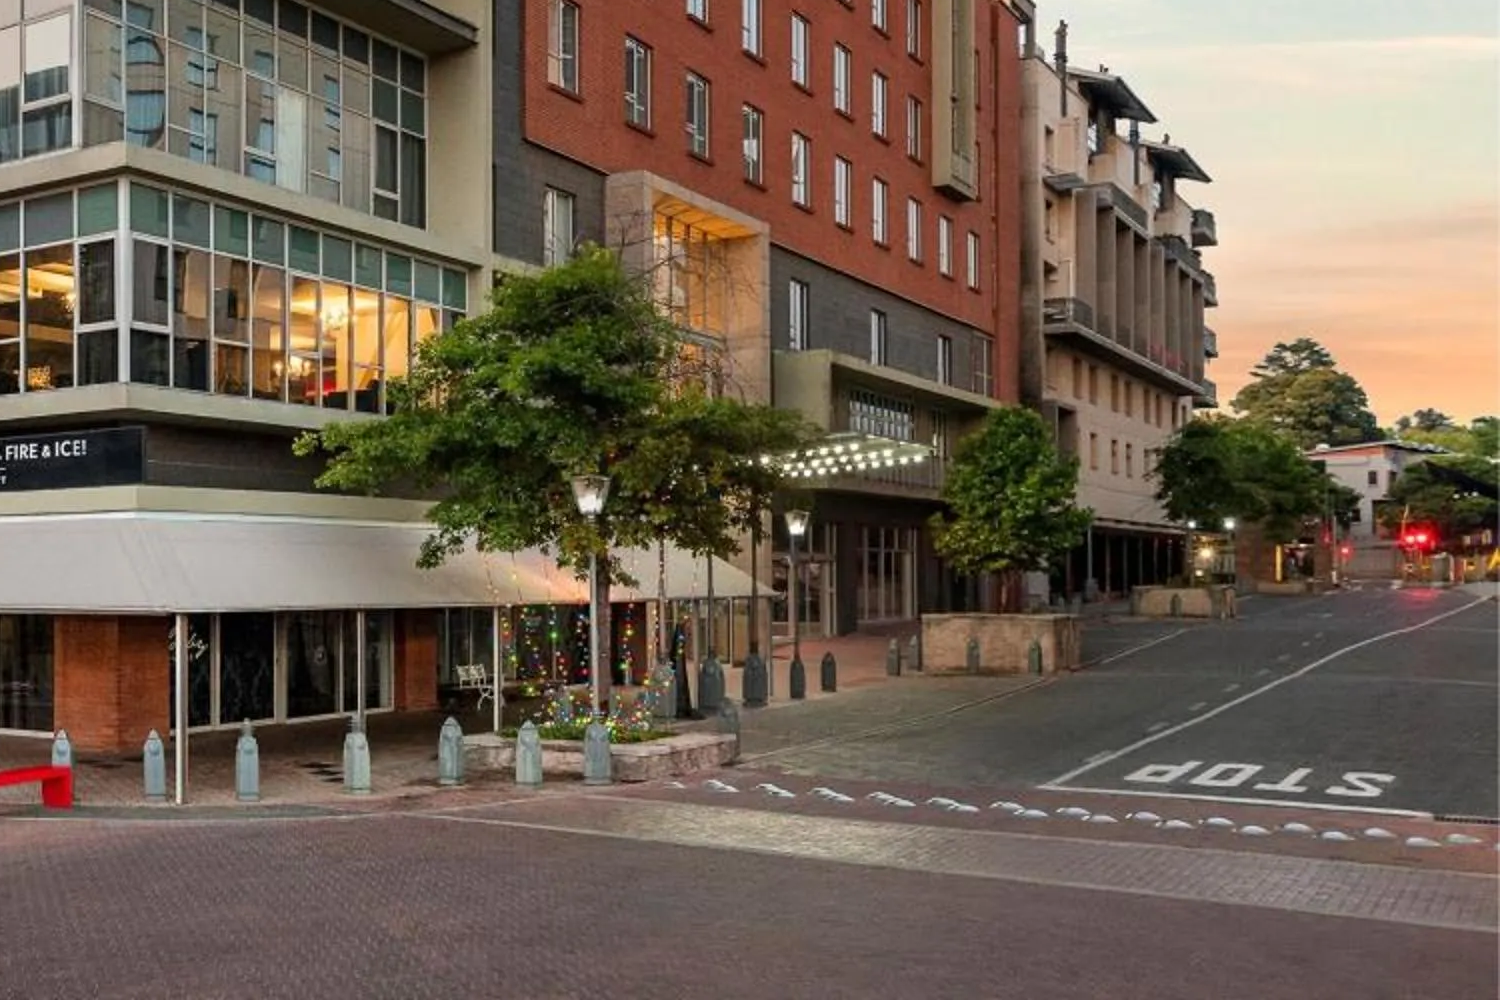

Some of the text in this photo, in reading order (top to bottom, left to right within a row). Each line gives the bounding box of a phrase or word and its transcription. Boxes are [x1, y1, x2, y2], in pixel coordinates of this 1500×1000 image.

[5, 443, 38, 460] FIRE
[41, 444, 50, 458] &
[55, 439, 87, 457] ICE!
[1124, 761, 1396, 797] STOP
